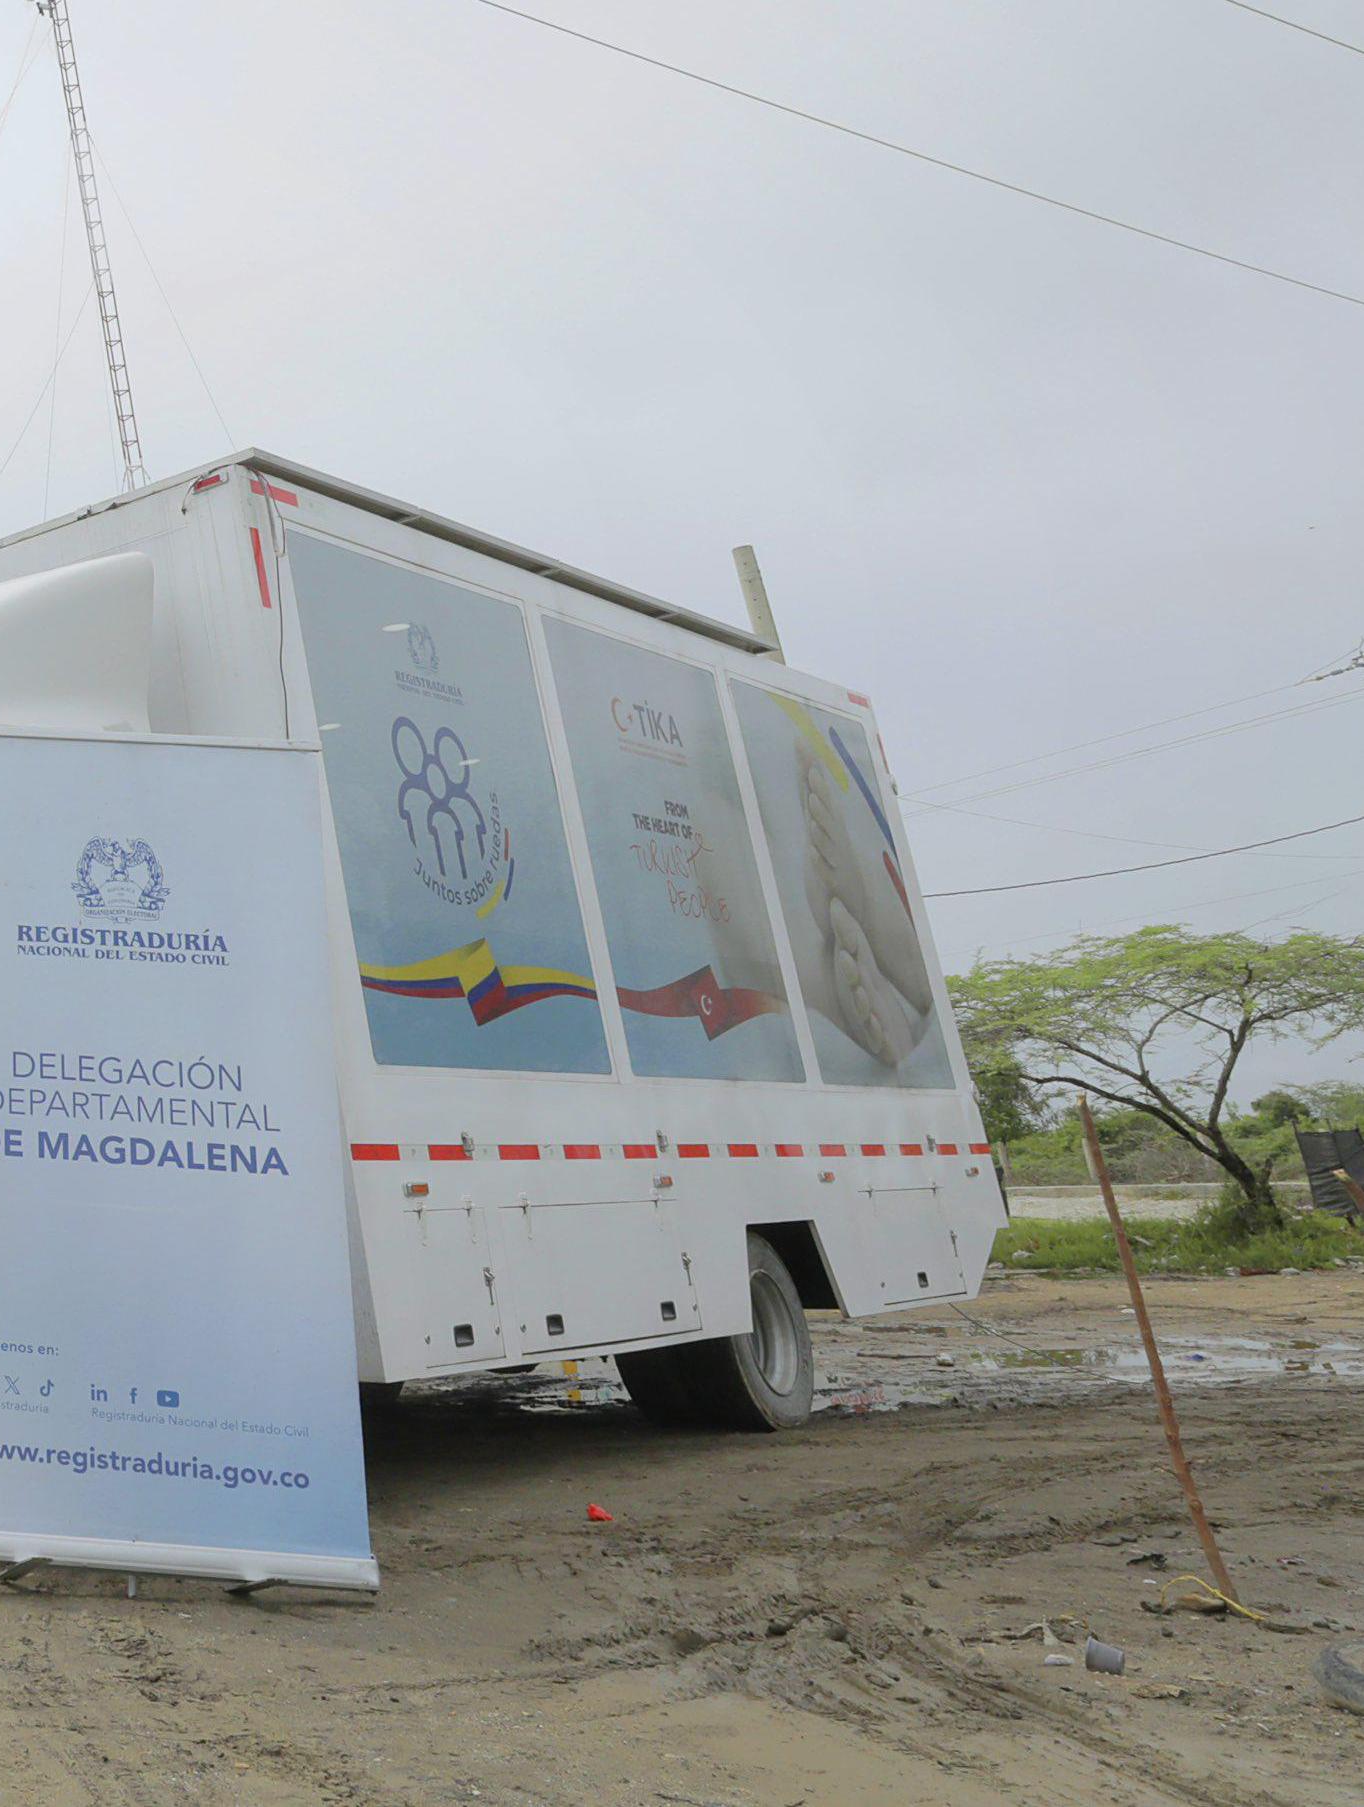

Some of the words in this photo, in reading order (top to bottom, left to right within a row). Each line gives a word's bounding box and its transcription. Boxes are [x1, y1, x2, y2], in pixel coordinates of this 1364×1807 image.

[664, 800, 690, 820] FROM
[632, 813, 652, 832] THE
[651, 817, 680, 838] HEART
[681, 824, 693, 840] OF
[413, 857, 463, 905] Juntos
[464, 870, 494, 905] sobre
[489, 792, 501, 872] ruedas
[17, 924, 229, 953] REGISTRADURÍA
[17, 944, 90, 958] NACIONAL
[94, 949, 124, 960] DEL
[129, 951, 187, 964] ESTADO
[190, 953, 230, 967] CIVIL
[11, 1050, 243, 1092] DELEGACIÓN
[37, 1130, 290, 1176] MAGDALENA
[37, 1345, 60, 1357] en:
[168, 1415, 218, 1430] Nacional
[221, 1420, 239, 1432] del
[241, 1422, 281, 1436] Estado
[284, 1425, 310, 1439] Civil
